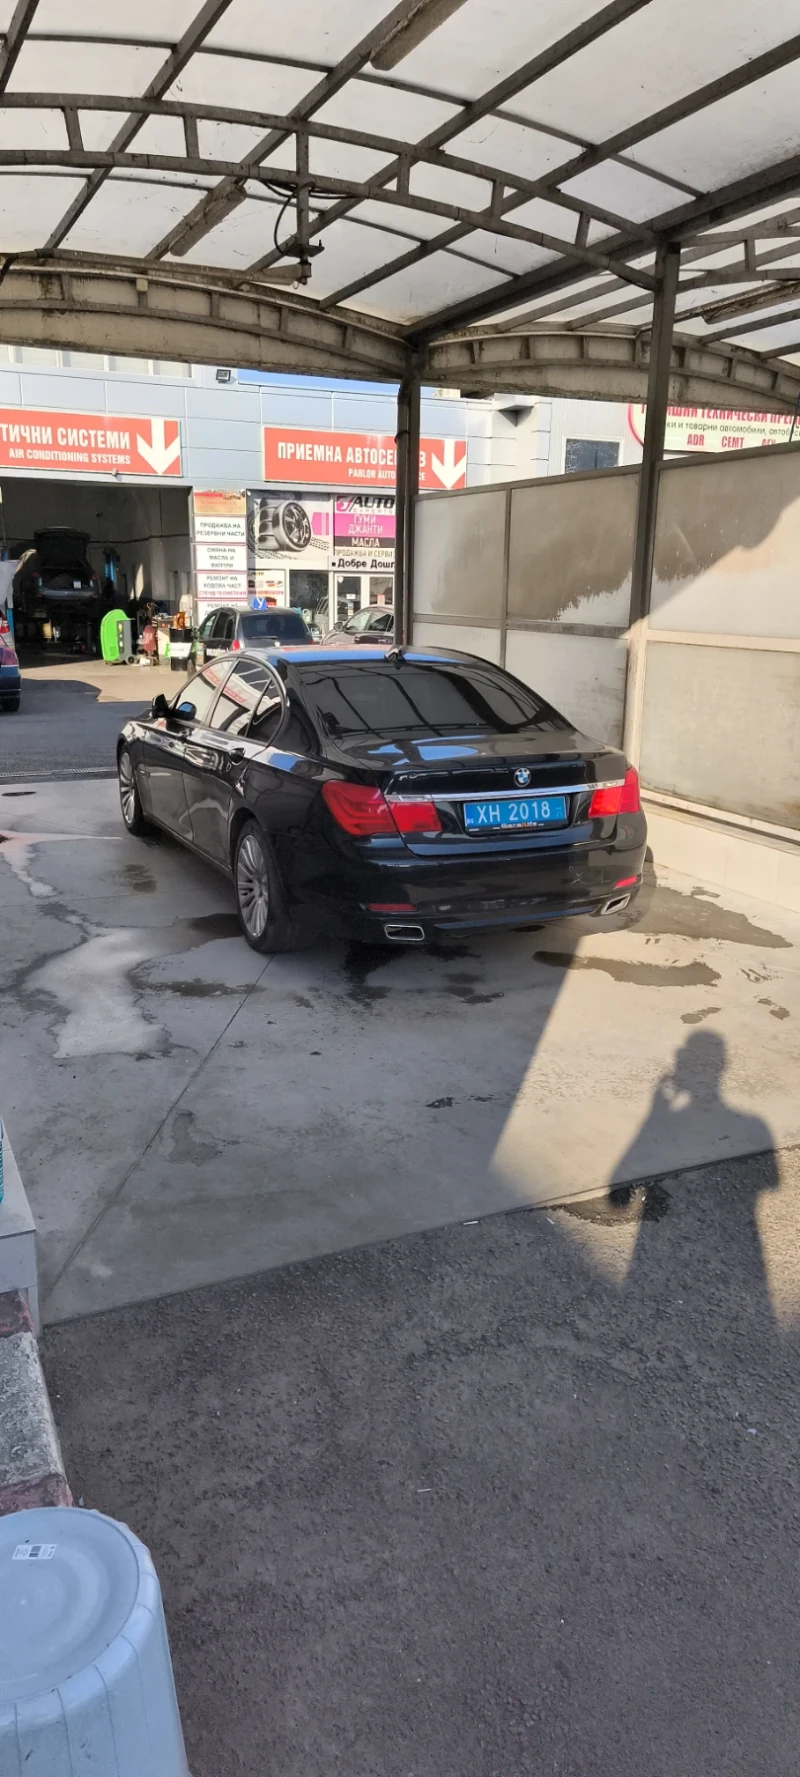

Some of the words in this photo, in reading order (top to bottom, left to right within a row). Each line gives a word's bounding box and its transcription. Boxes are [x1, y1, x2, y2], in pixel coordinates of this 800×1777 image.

[685, 423, 717, 432] товарни
[57, 427, 131, 449] СИСТЕМИ
[687, 434, 705, 446] ADR
[721, 436, 745, 448] CEMT
[9, 448, 24, 459] AIR
[26, 450, 89, 463] CONDITIONING
[91, 453, 131, 465] SYSTEMS
[278, 442, 343, 463] ПРИЕМНА
[346, 447, 427, 468] АВТОСЕЗ
[348, 468, 376, 479] PARLOR
[352, 496, 396, 509] AUTO
[354, 514, 377, 524] ГУМИ
[348, 524, 384, 535] ДЖАНТИ
[351, 537, 380, 547] МАСЛА
[374, 550, 395, 558] СЕРВИ
[337, 558, 367, 569] Добре
[477, 804, 500, 824] XH
[508, 801, 550, 821] 2018
